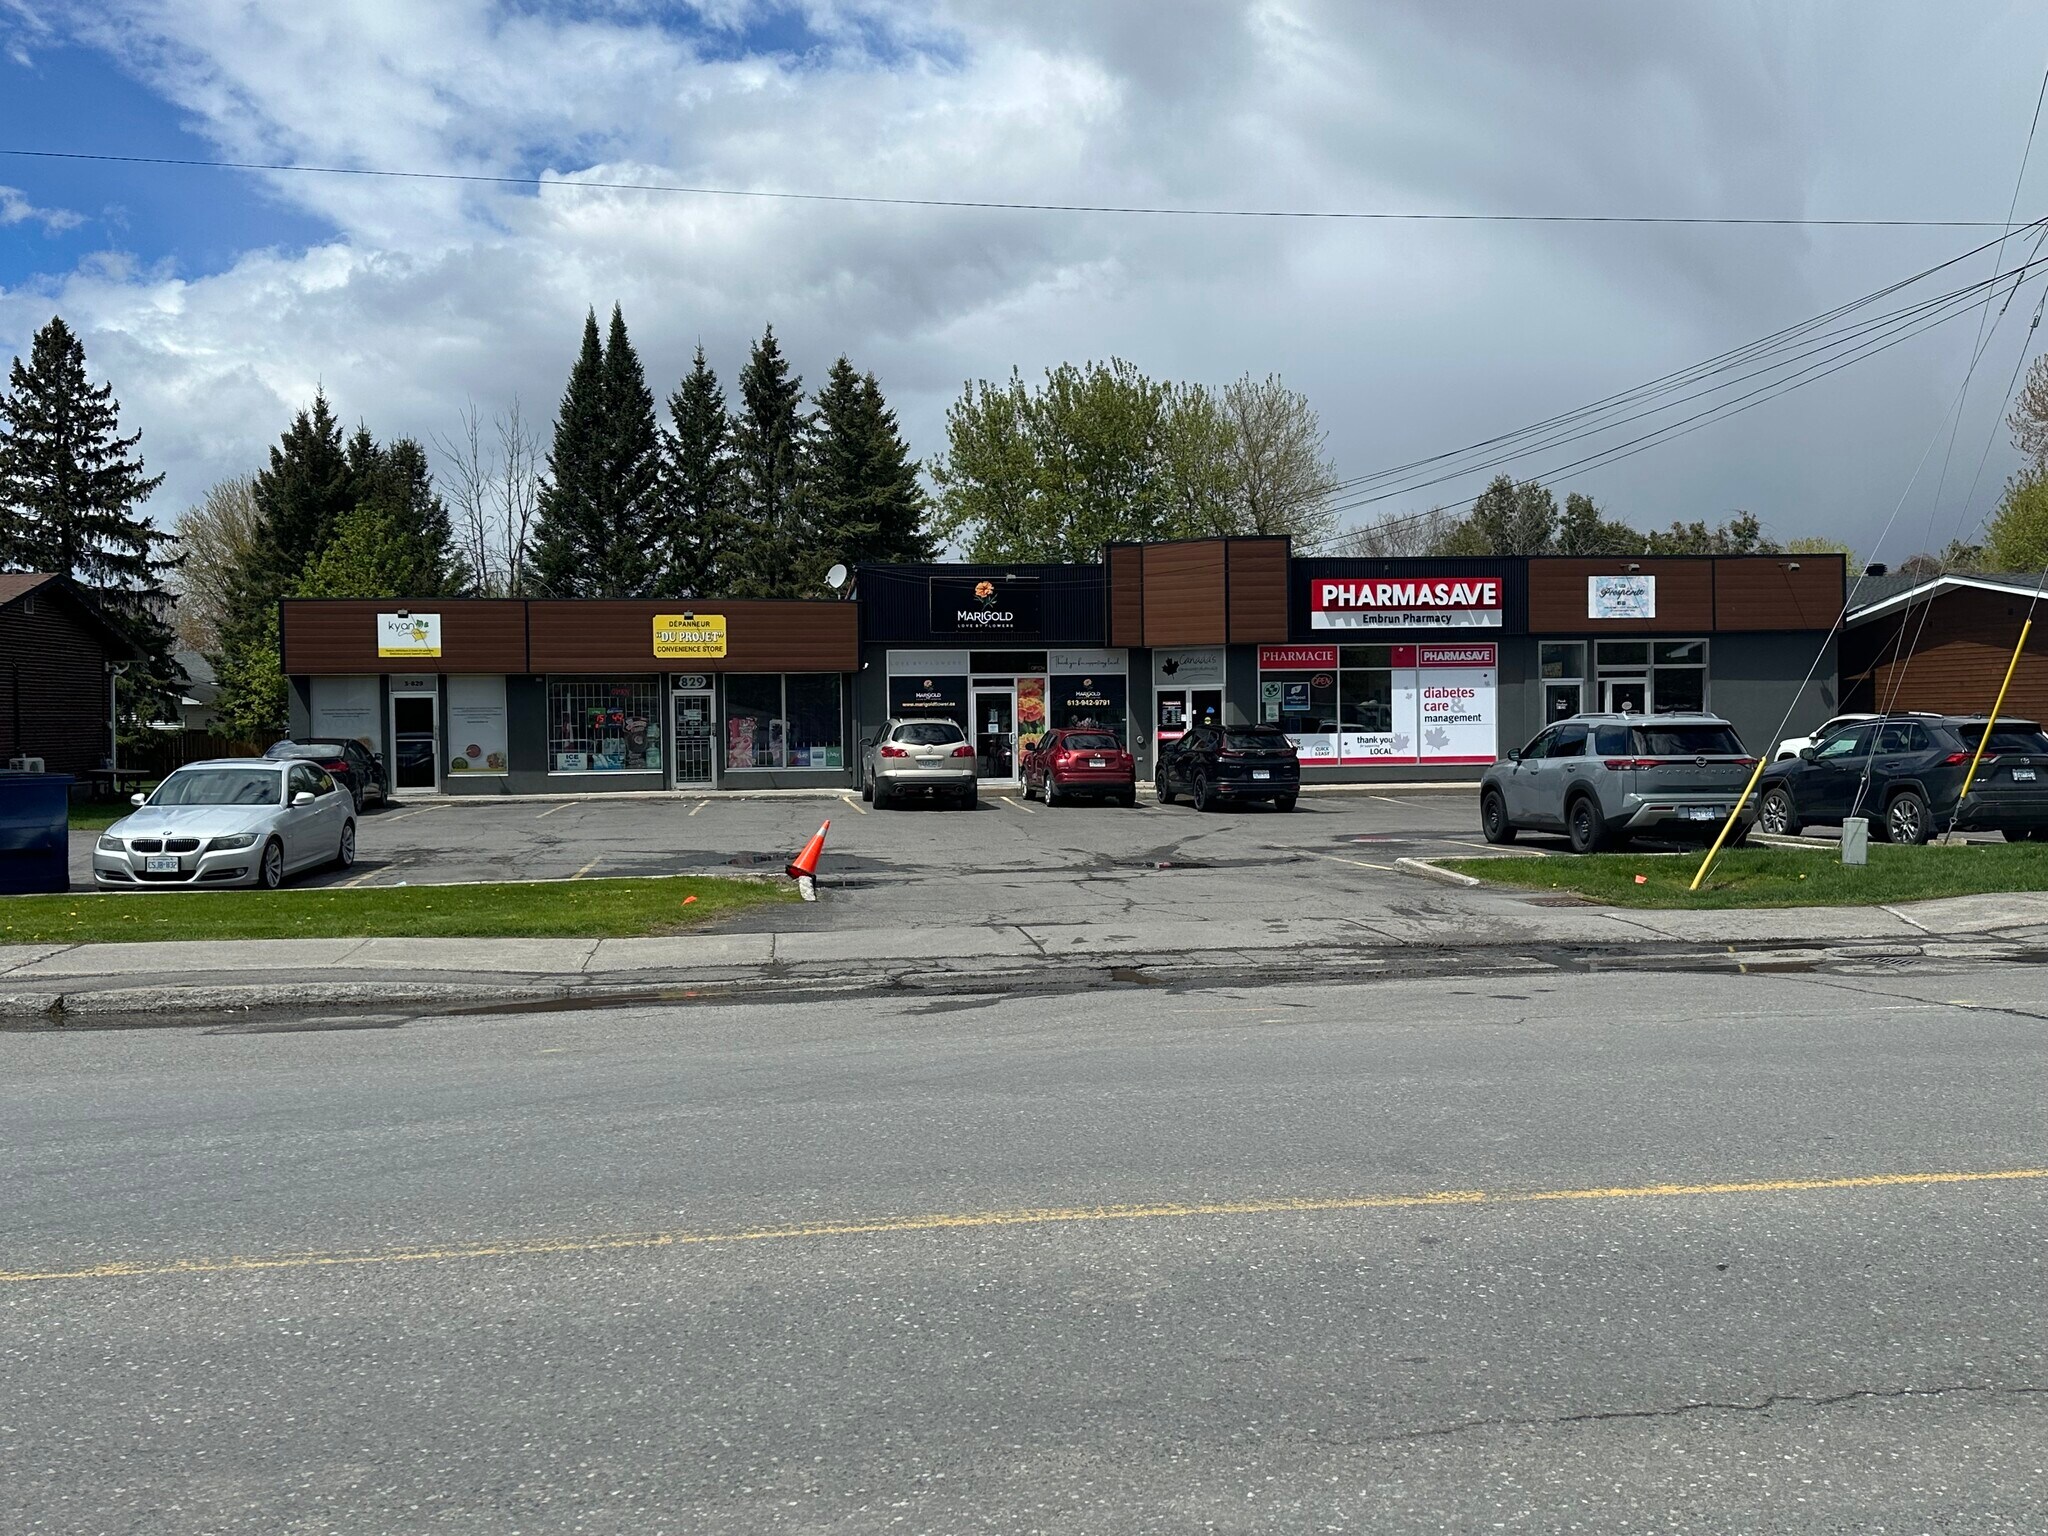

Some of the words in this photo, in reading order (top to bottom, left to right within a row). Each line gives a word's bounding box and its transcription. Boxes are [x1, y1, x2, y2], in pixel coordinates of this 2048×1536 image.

[1322, 583, 1496, 606] PHARMASAVE
[957, 611, 1014, 624] MARIGOLD
[1363, 613, 1400, 624] Embrun
[1403, 612, 1453, 625] Pharmacy
[668, 620, 711, 628] DÉPANNEUR
[1263, 651, 1334, 661] PHARMACIE
[1424, 651, 1490, 661] PHARMASAVE
[681, 678, 704, 687] 829
[1424, 686, 1475, 699] diabetes
[1424, 701, 1449, 712] care
[1424, 713, 1482, 724] management
[1357, 735, 1378, 744] thank
[1379, 737, 1393, 745] you
[1370, 747, 1392, 755] LOCAL
